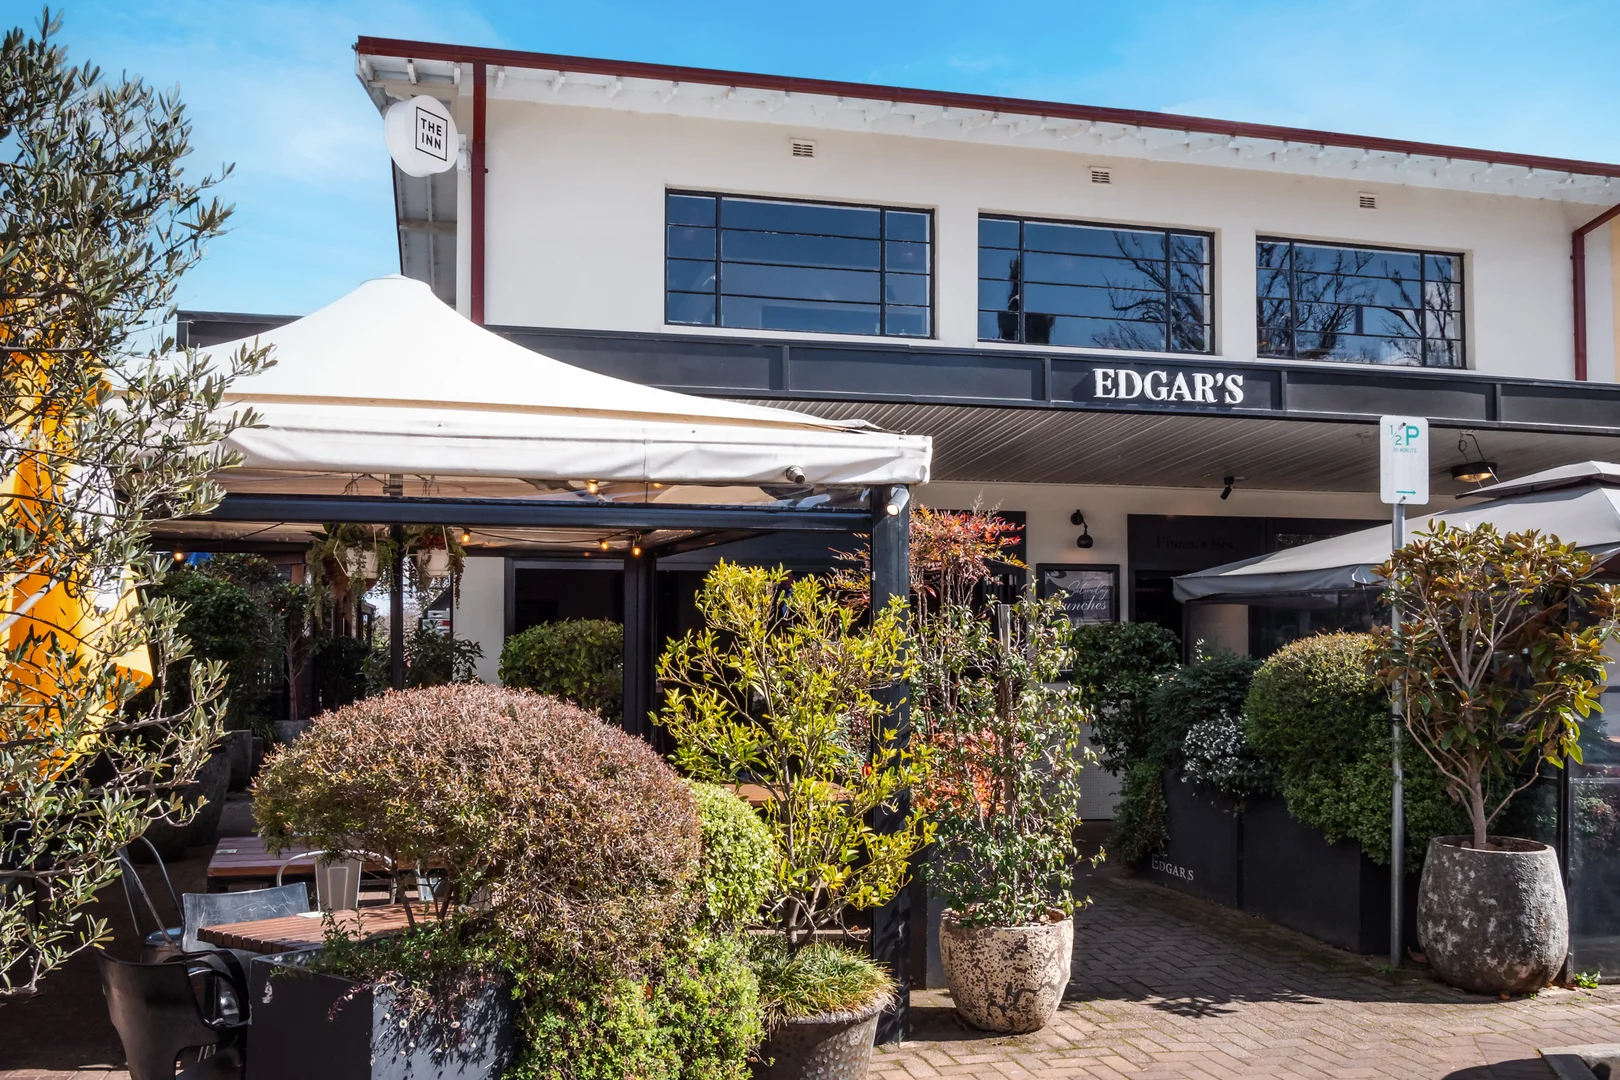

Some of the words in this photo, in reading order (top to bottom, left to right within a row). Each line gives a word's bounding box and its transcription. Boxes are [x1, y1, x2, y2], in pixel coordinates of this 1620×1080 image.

[421, 118, 442, 136] THE
[422, 133, 441, 150] INN
[1093, 368, 1244, 404] EDGAR'S
[1060, 595, 1106, 611] unches
